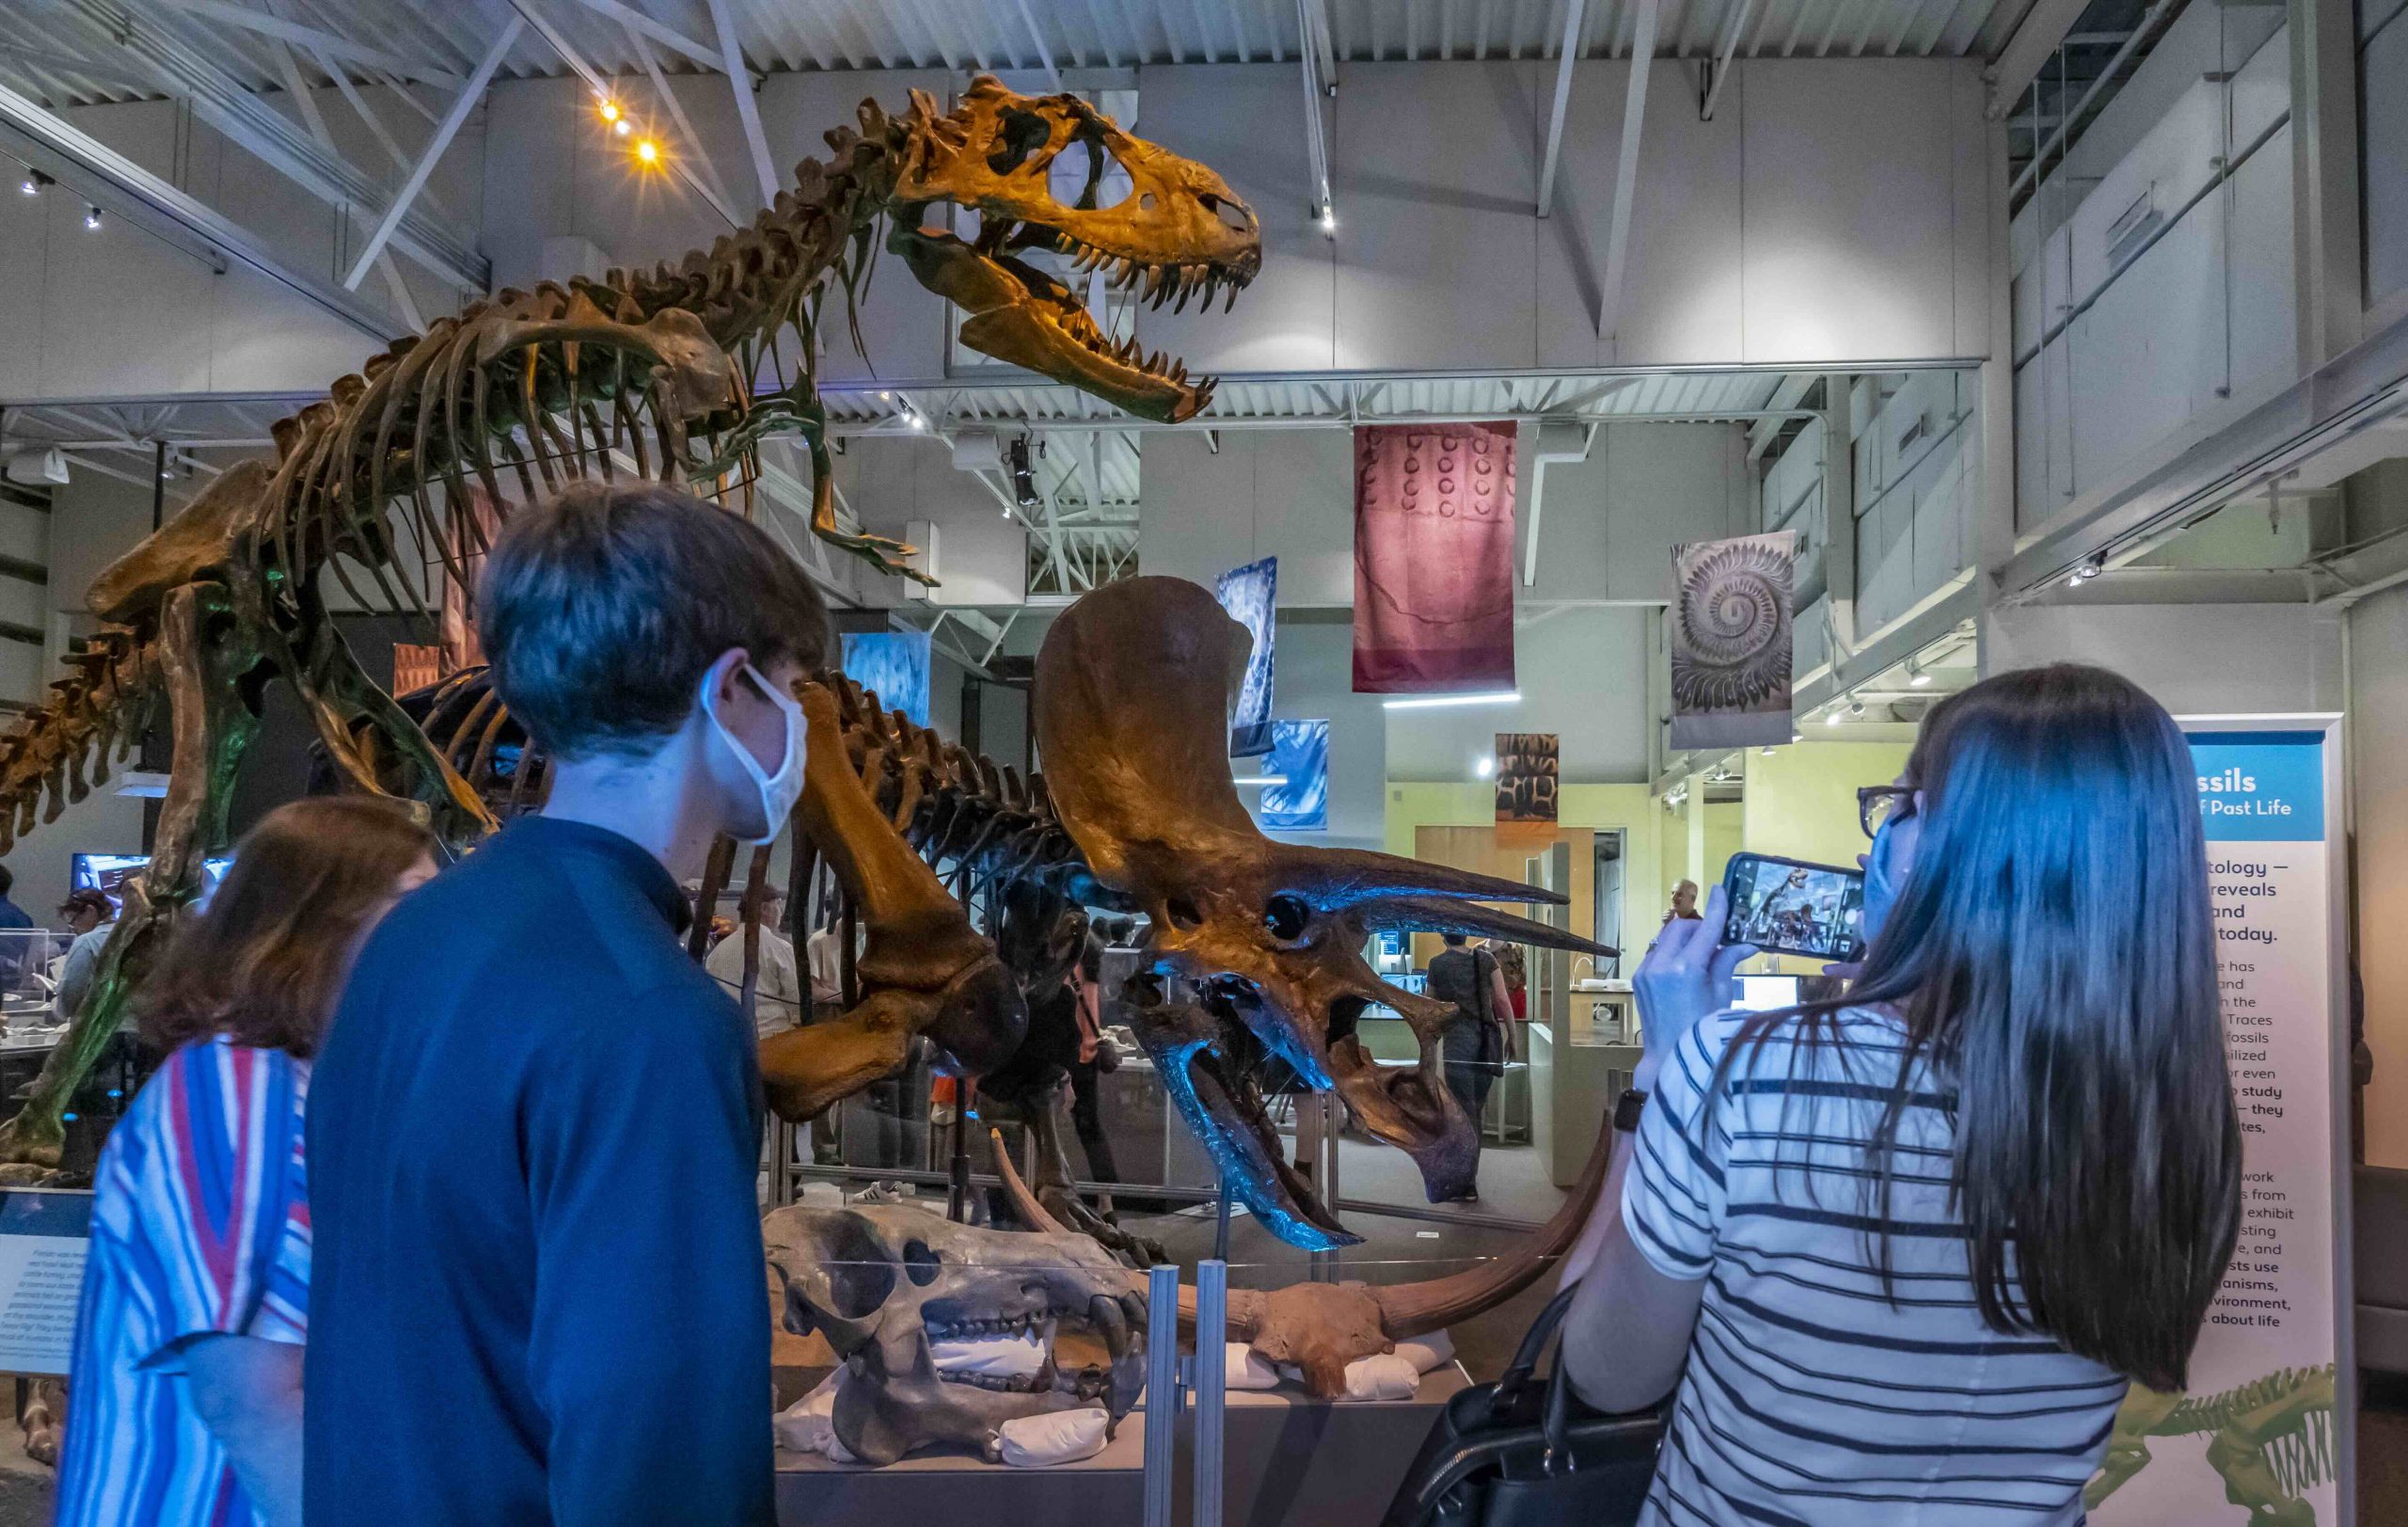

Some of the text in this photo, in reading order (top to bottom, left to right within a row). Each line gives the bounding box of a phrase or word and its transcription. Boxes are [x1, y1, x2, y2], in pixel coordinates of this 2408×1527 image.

[2196, 767, 2257, 792] ssils
[2211, 800, 2251, 815] Past
[2257, 799, 2292, 815] Life
[2210, 883, 2276, 896] reveals
[2218, 927, 2277, 945] today.
[2230, 961, 2255, 972] has
[2233, 996, 2256, 1008] the
[2226, 1013, 2273, 1026] Traces
[2226, 1031, 2269, 1043] fossils
[2242, 1070, 2276, 1079] even
[2242, 1086, 2282, 1100] study
[2252, 1104, 2283, 1118] they
[2242, 1171, 2274, 1183] work
[2252, 1188, 2286, 1201] from
[2248, 1207, 2294, 1220] exhibit
[2254, 1244, 2281, 1255] and
[2254, 1264, 2279, 1273] use
[2211, 1312, 2254, 1326] about
[2258, 1315, 2280, 1328] life
